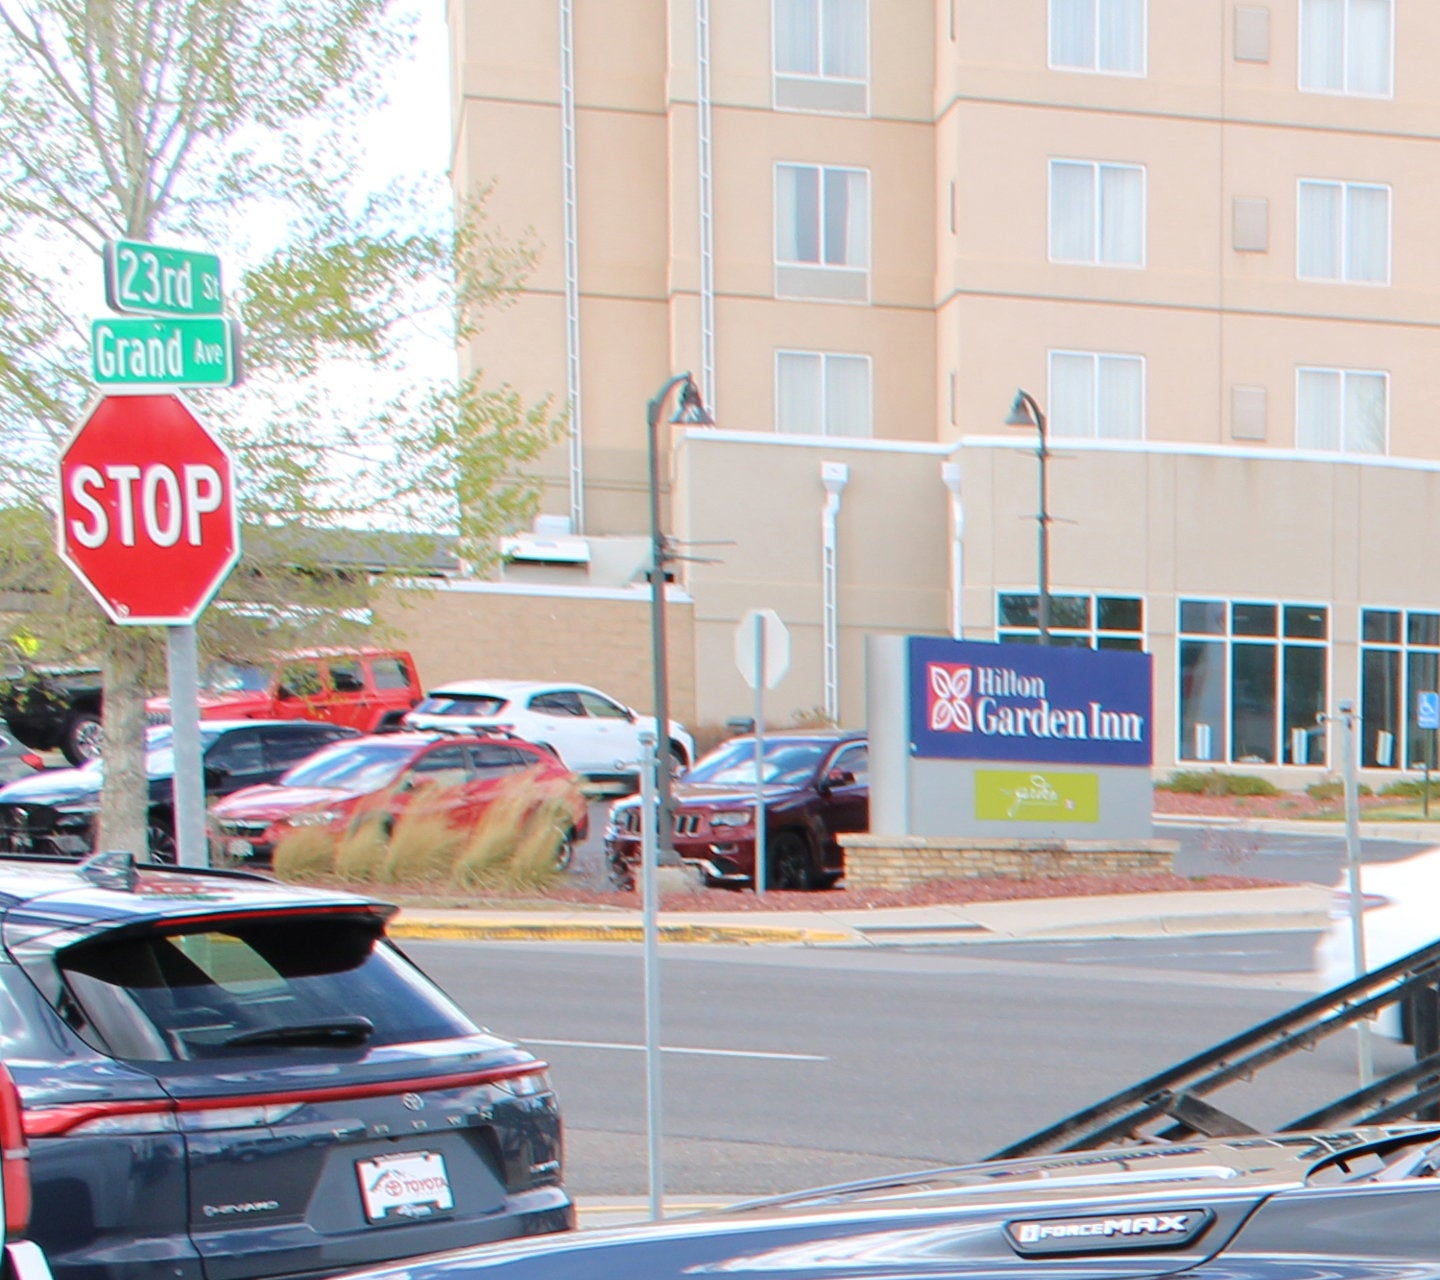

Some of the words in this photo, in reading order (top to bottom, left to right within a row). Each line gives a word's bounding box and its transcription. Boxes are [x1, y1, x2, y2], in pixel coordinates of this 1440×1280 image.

[120, 248, 193, 310] 23rd
[95, 325, 184, 378] Grand
[193, 337, 224, 366] Ave
[70, 463, 224, 549] STOP
[976, 666, 1046, 699] Hilton
[975, 696, 1087, 741] Garden
[1088, 701, 1144, 742] Inn
[403, 1176, 449, 1193] TOYOTA
